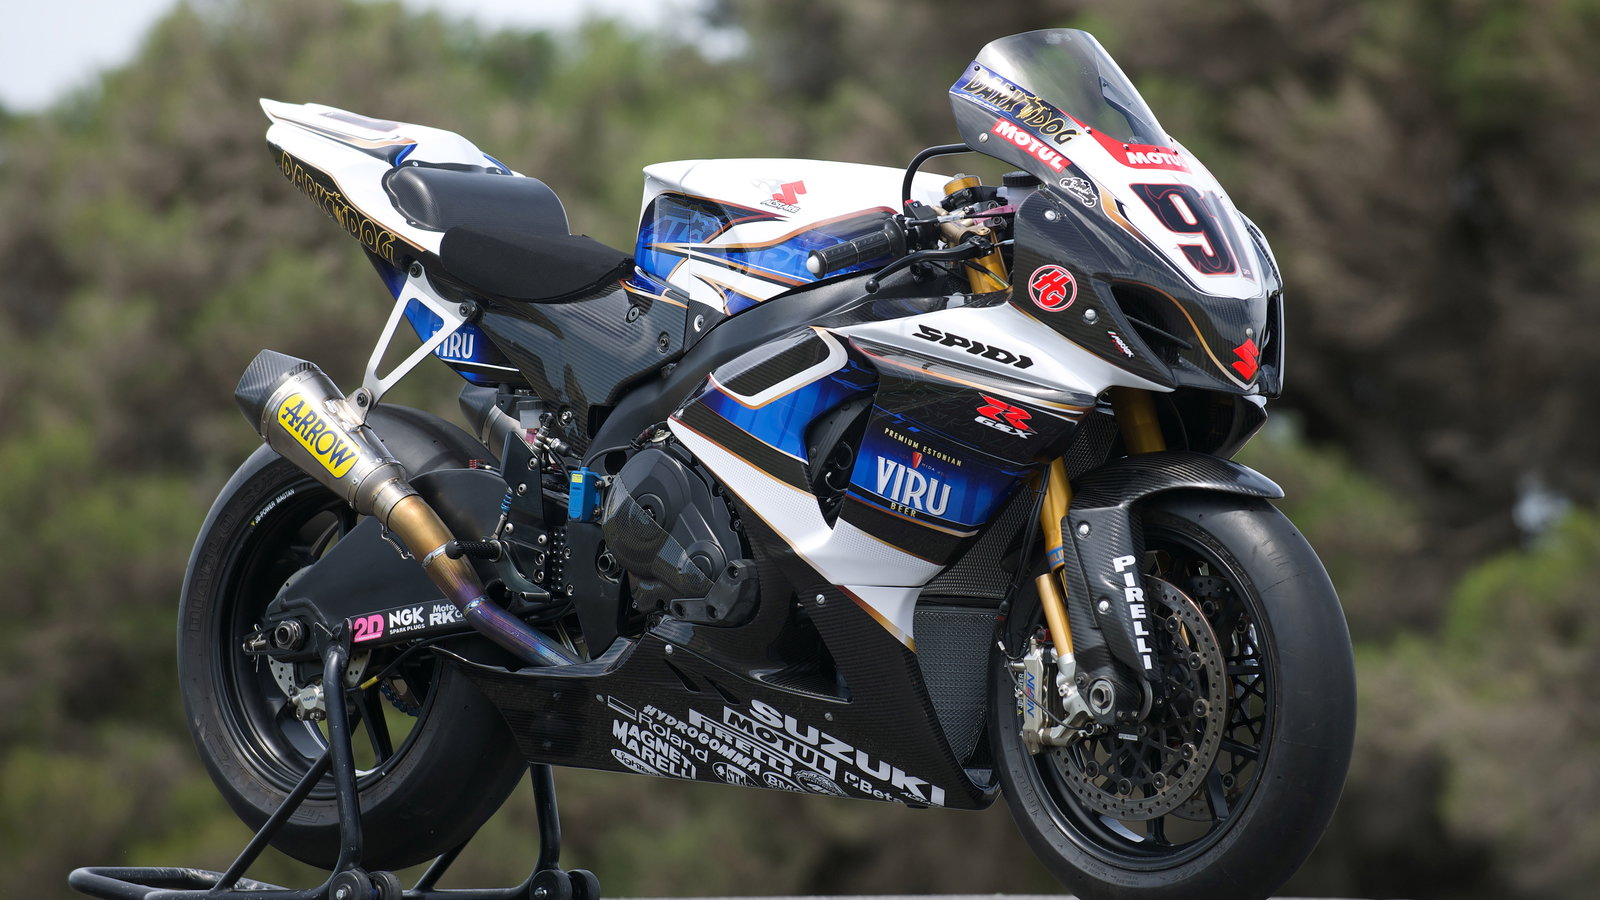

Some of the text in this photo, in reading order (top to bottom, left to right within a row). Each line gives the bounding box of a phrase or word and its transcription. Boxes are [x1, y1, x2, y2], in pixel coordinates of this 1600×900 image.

[995, 121, 1064, 169] MOTUL
[1023, 109, 1077, 145] DOG
[345, 205, 396, 267] DOG
[912, 324, 1034, 369] SPIDI
[282, 400, 355, 470] ARROW
[884, 427, 919, 450] PREMIUM
[922, 445, 963, 467] ESTONIAN
[974, 416, 1034, 440] GSX
[877, 455, 951, 516] VIRU
[890, 501, 917, 518] BEER
[353, 614, 385, 643] 2D
[388, 605, 425, 628] NGK
[389, 623, 426, 635] SPARK PLUGS
[429, 611, 456, 627] RK
[1113, 554, 1152, 670] PIRELLI
[612, 719, 697, 771] MAGNETI
[636, 710, 709, 763] Roland
[643, 704, 761, 776] HYDROGOMMA
[689, 708, 794, 777] PIRELLI
[723, 706, 837, 780] MOTUL
[749, 699, 945, 807] SUZUKI
